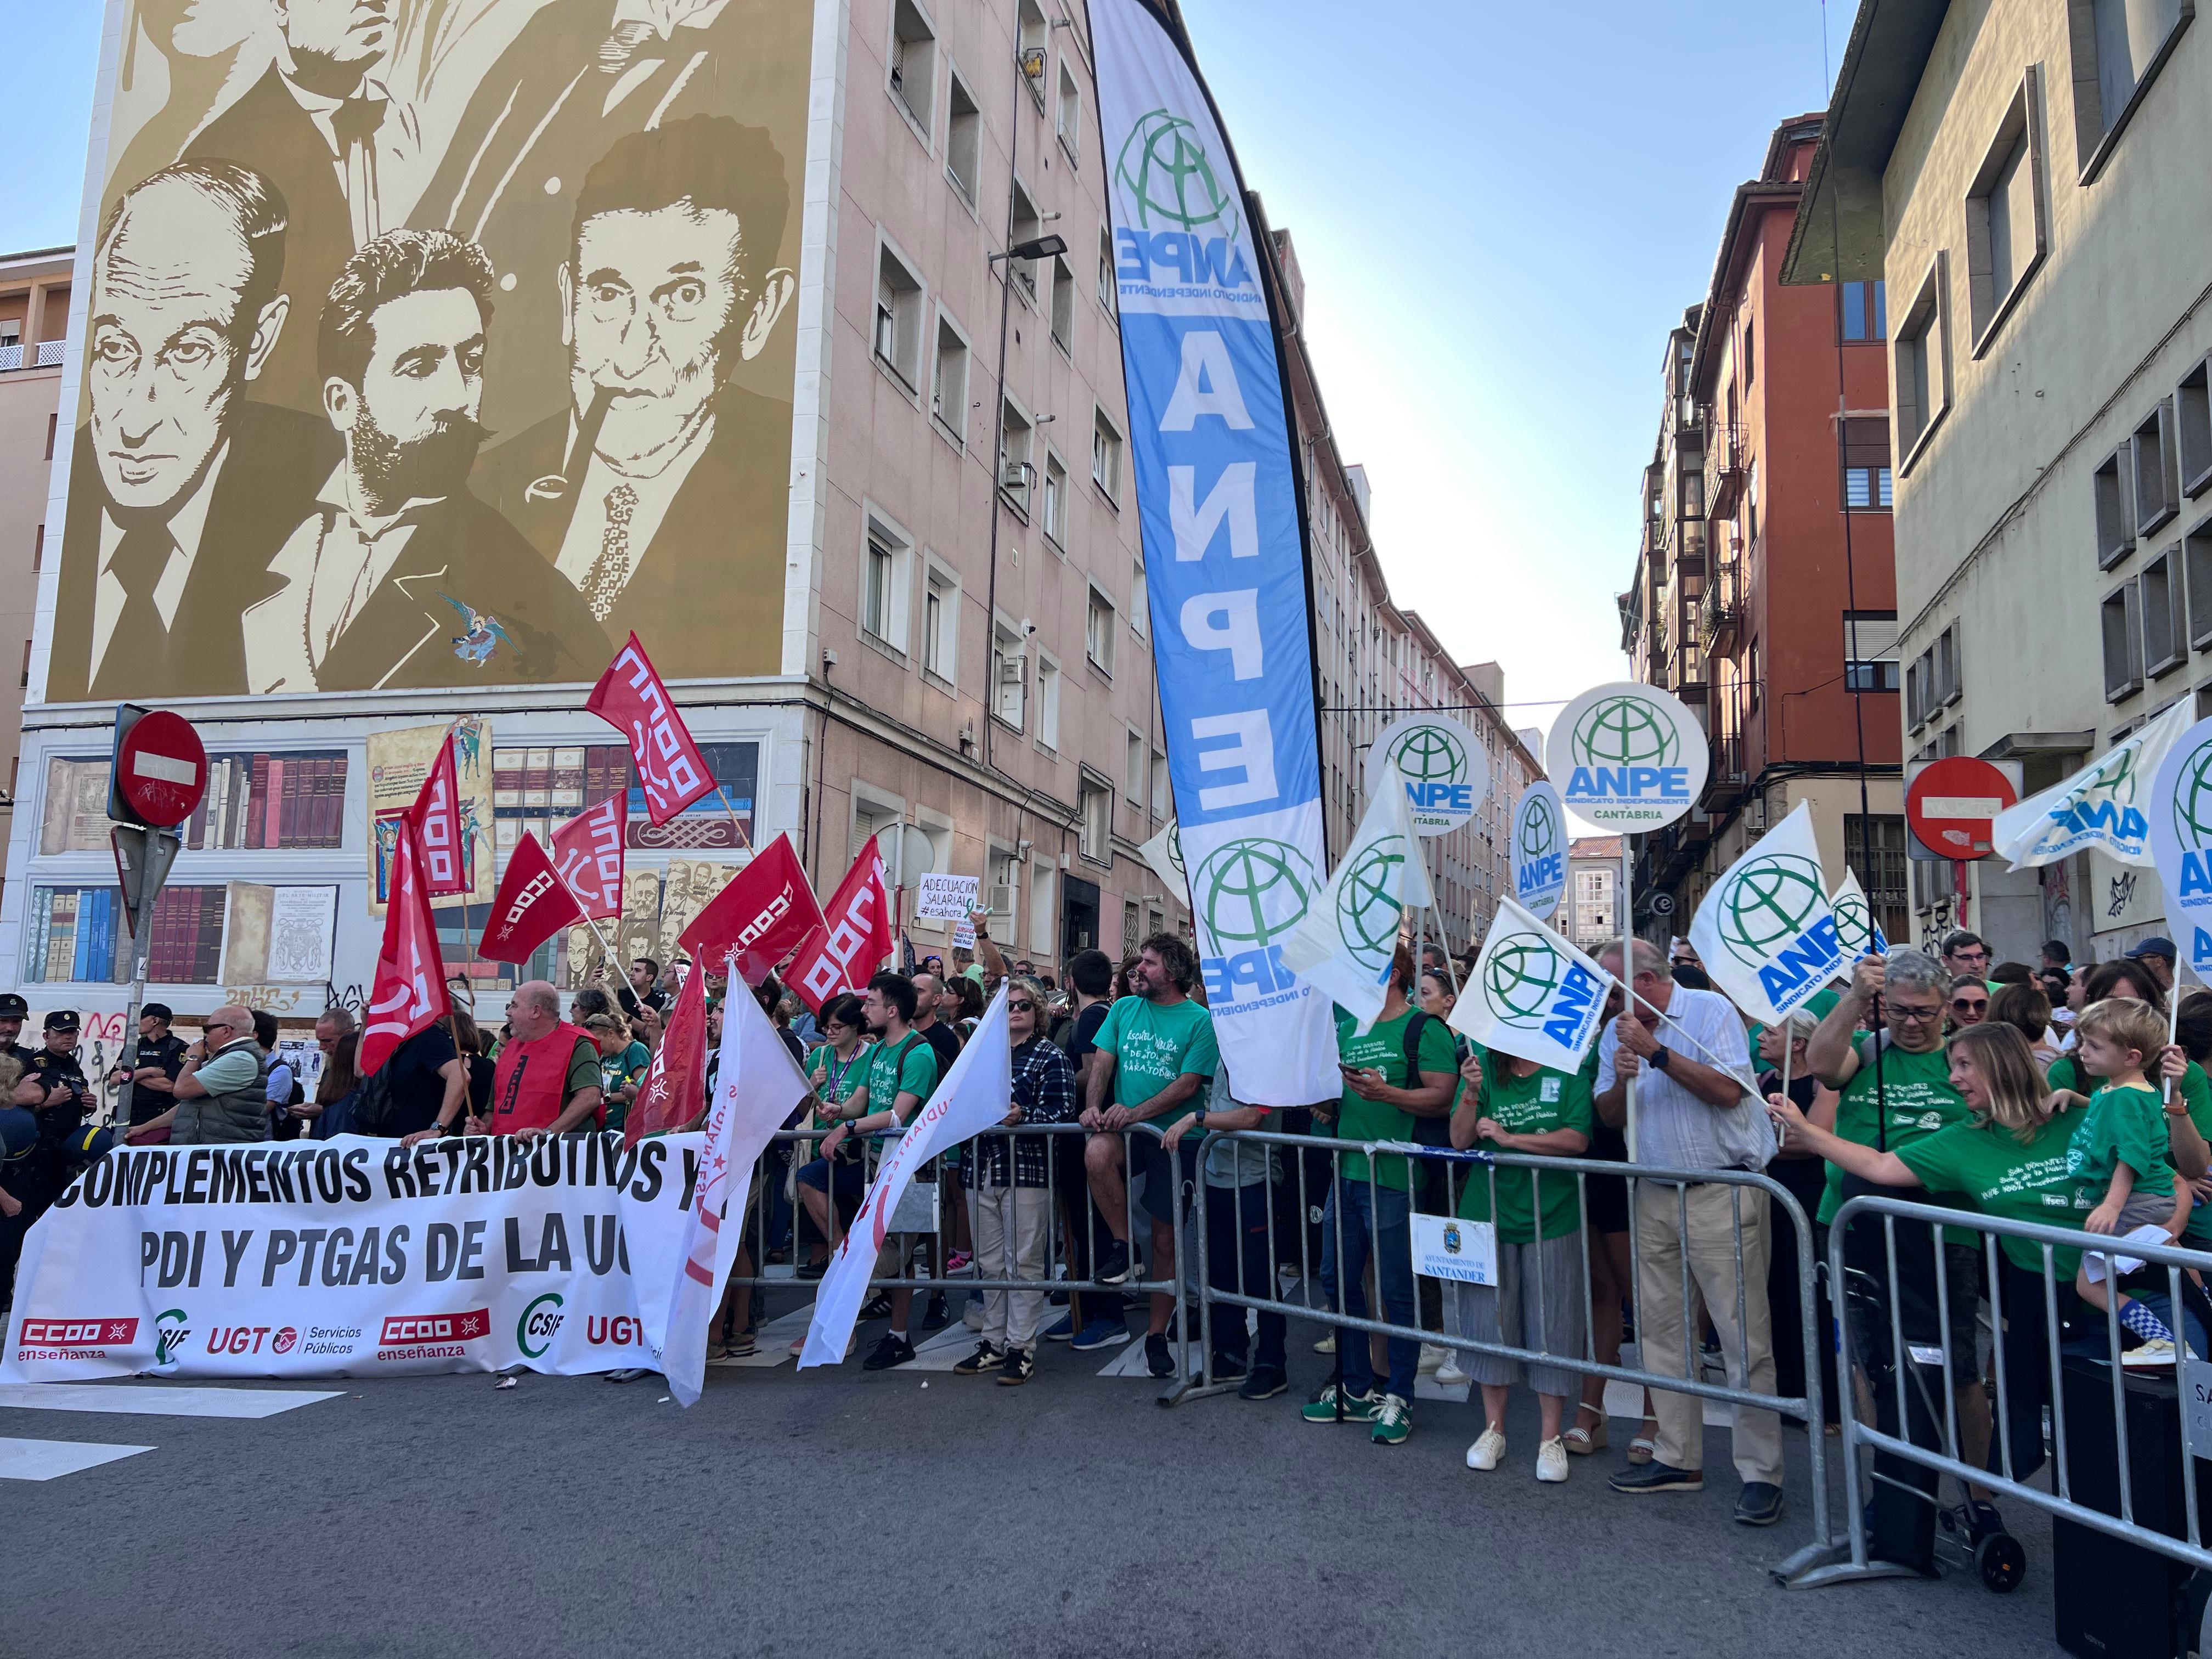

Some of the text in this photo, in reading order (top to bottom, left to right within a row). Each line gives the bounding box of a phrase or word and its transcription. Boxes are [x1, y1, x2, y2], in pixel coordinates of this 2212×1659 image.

[1565, 767, 1690, 797] ANPE
[1405, 782, 1472, 809] NPE
[1414, 817, 1450, 826] TABRIA
[1594, 810, 1663, 819] CANTABRIA
[1519, 851, 1563, 893] ANPE
[1758, 915, 1840, 1007] ANP
[1776, 974, 1823, 1014] SINDICATO
[1572, 1011, 1595, 1052] SINDICATO
[55, 1132, 702, 1212] COMPLEMENTOS RETRIBUTIVOS Y
[141, 1231, 206, 1288] PDI
[221, 1229, 254, 1288] Y
[262, 1224, 410, 1287] PTGAS
[426, 1220, 487, 1282] DE
[506, 1213, 572, 1273] LA
[1424, 1255, 1485, 1269] AYUNTAMIENTO DE
[1425, 1264, 1486, 1283] SANTANDER
[24, 1324, 100, 1341] CCOO
[309, 1326, 362, 1339] Servicios
[385, 1319, 453, 1340] CCOO
[528, 1312, 564, 1337] CSIF
[587, 1315, 644, 1347] UGT
[159, 1329, 191, 1351] SIF
[207, 1327, 271, 1355] UGT
[304, 1342, 353, 1355] Públicos
[18, 1347, 107, 1362] enseñanza
[377, 1344, 465, 1361] enseñanza
